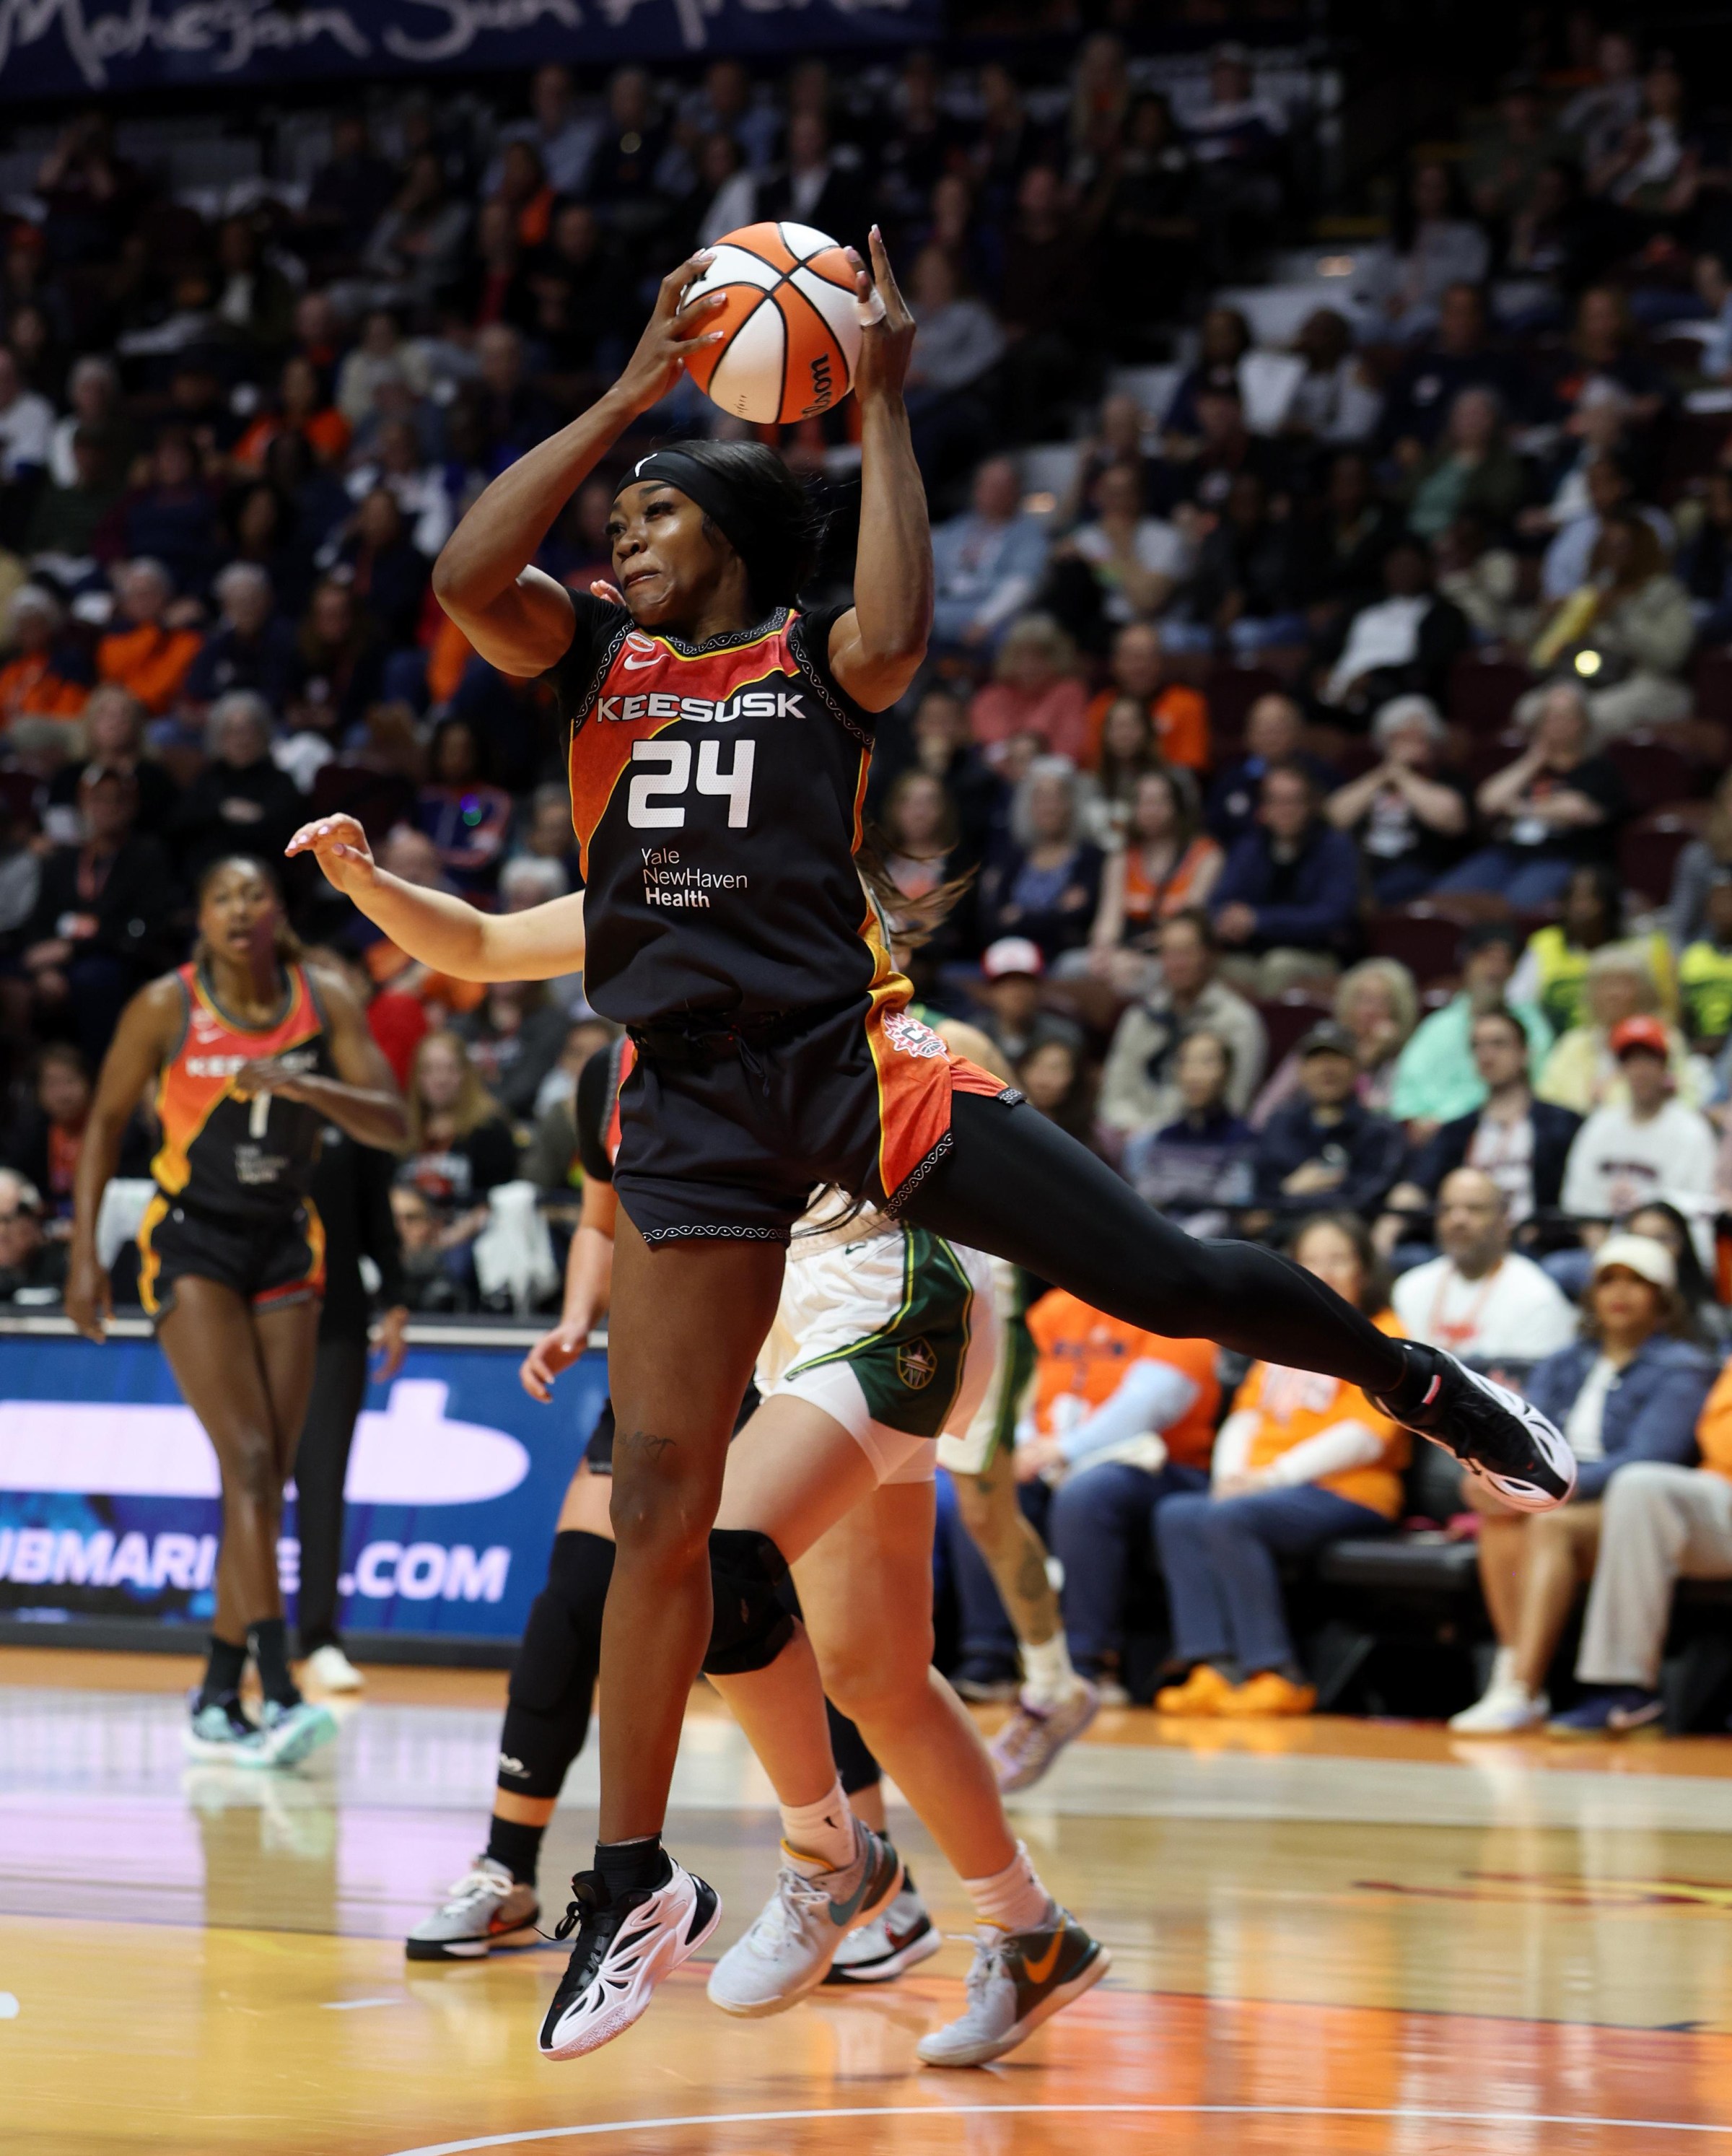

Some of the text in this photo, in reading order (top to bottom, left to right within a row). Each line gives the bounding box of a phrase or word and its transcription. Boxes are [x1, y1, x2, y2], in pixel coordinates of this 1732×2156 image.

[801, 353, 831, 416] lson
[596, 692, 807, 723] KEESUSK
[626, 739, 756, 829] 24
[641, 847, 680, 866] Yale
[642, 867, 748, 889] NewHaven
[645, 887, 711, 908] Health
